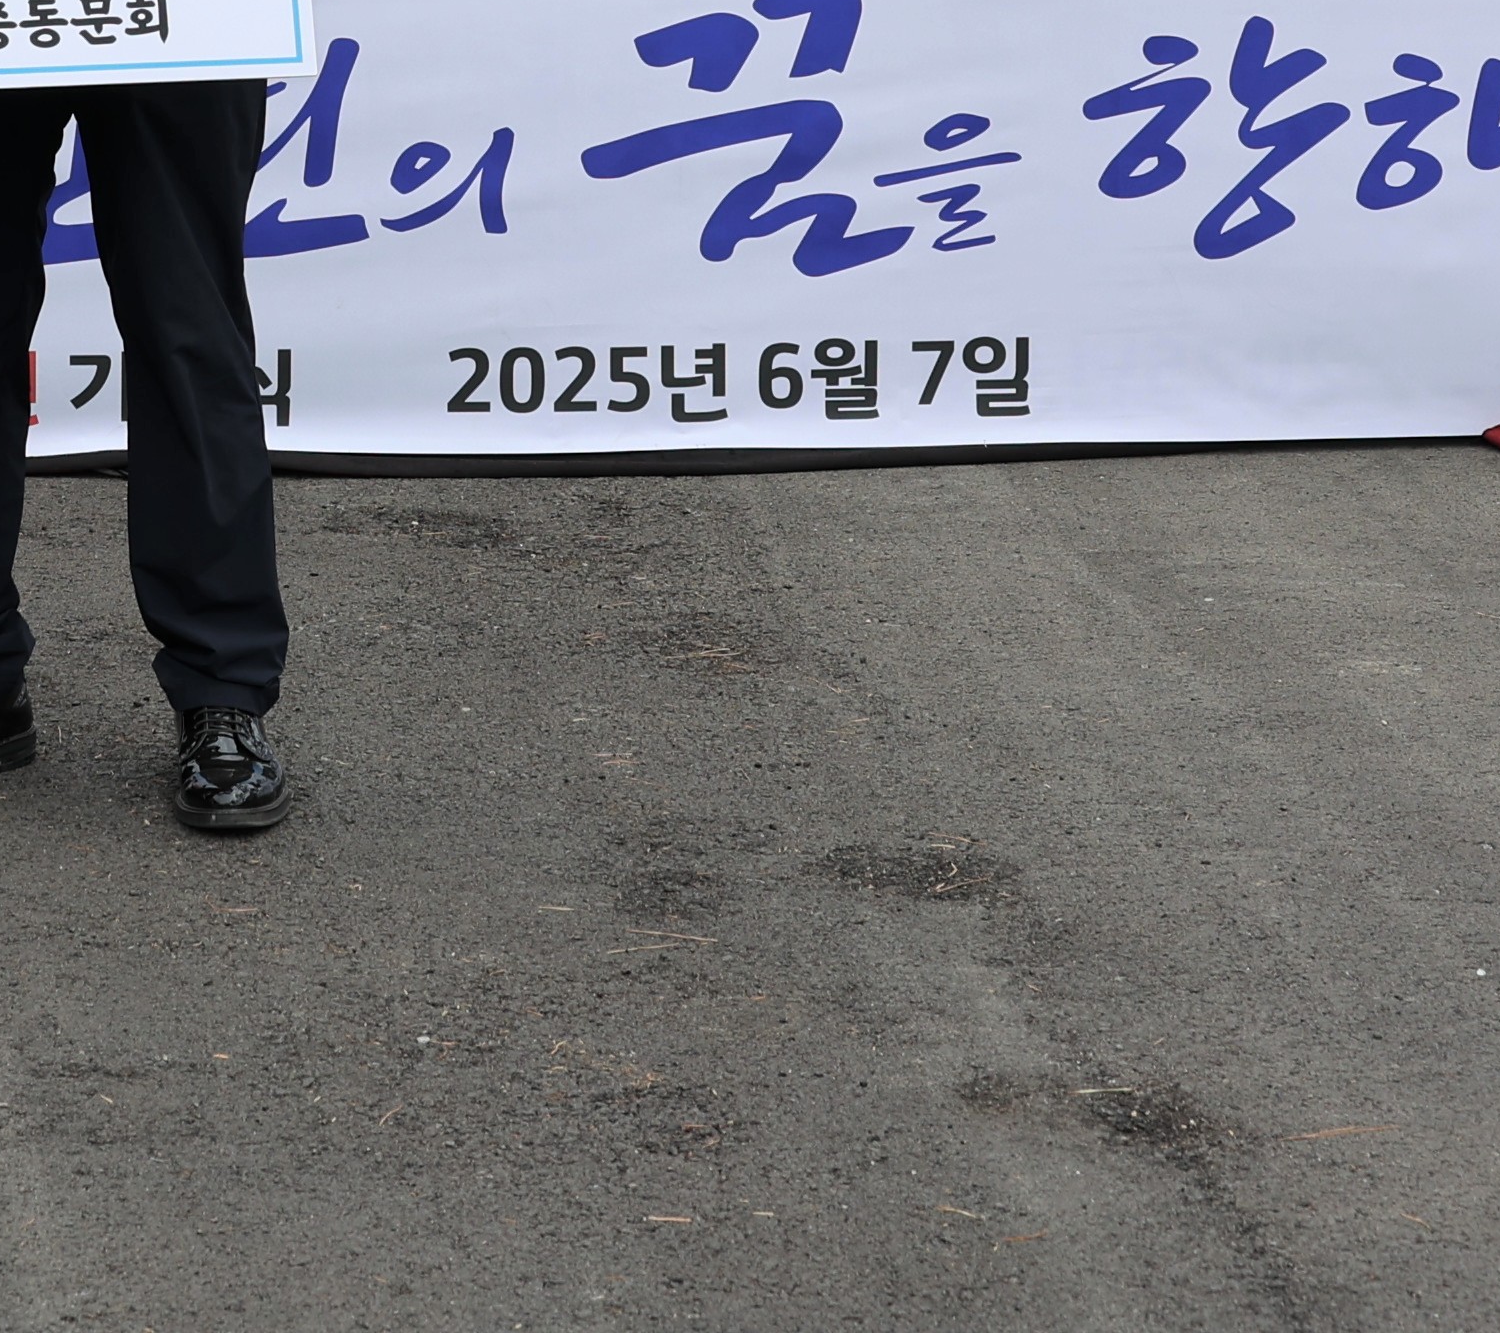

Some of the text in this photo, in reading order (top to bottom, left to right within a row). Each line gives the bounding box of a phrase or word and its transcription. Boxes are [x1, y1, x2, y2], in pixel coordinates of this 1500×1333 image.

[446, 342, 728, 423] 2025년
[758, 338, 880, 420] 6월
[911, 336, 1031, 417] 7일
